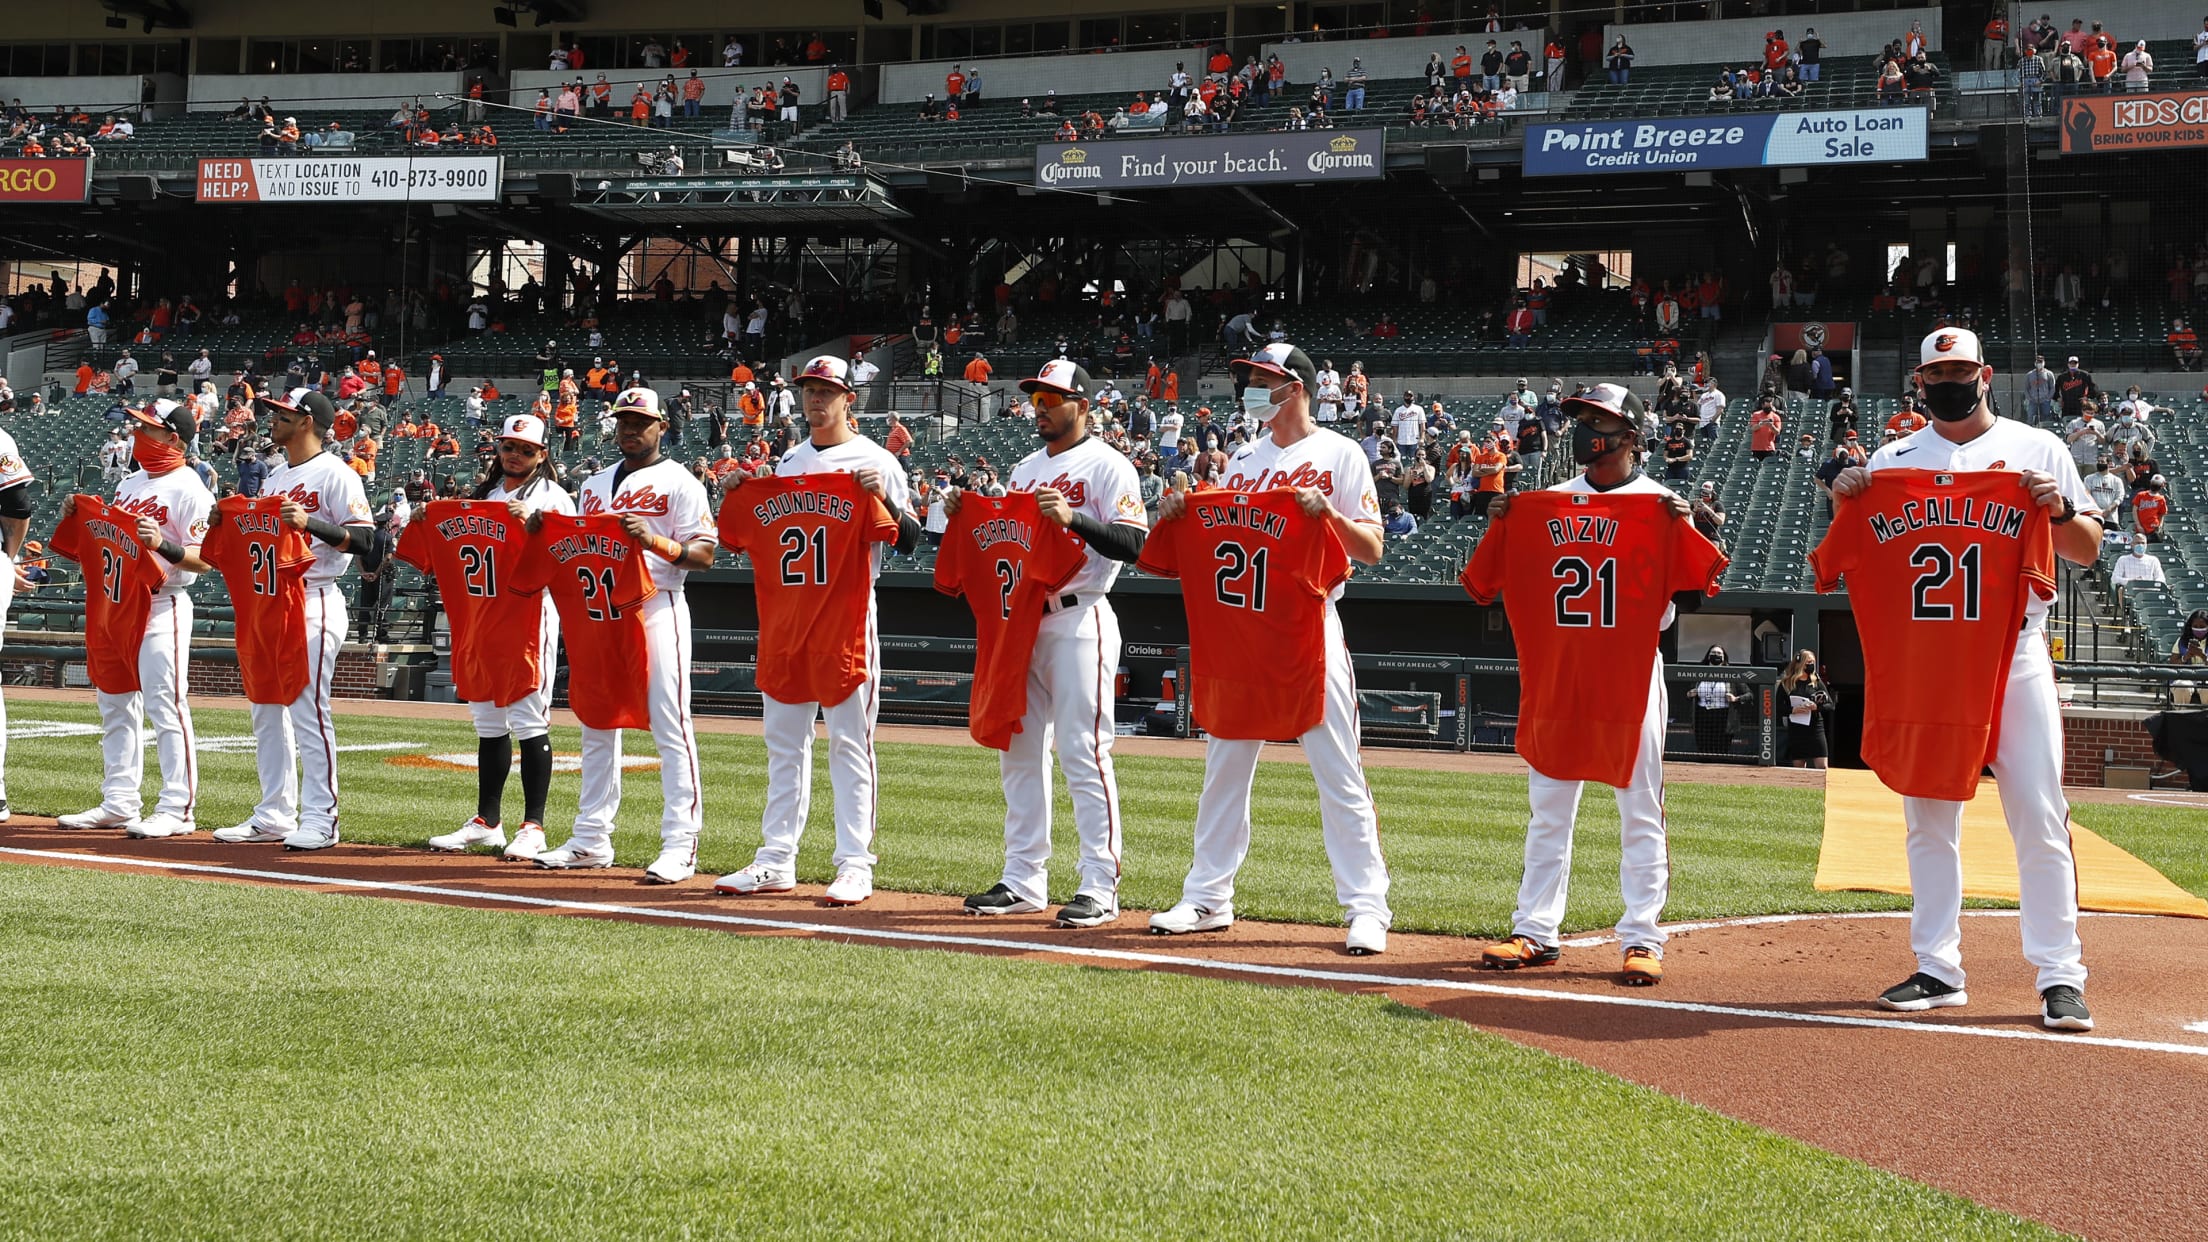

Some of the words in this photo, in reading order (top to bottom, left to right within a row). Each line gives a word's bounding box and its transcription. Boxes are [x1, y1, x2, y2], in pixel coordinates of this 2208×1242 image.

[1633, 125, 1744, 148] Breeze
[1796, 117, 1847, 134] Auto
[1855, 115, 1903, 131] Loan
[2093, 133, 2133, 145] BRING
[2136, 131, 2170, 143] YOUR
[2174, 129, 2204, 141] KIDS
[1586, 152, 1640, 167] Credit
[1645, 150, 1697, 164] Union
[1825, 136, 1874, 158] Sale
[203, 163, 242, 179] NEED
[258, 163, 290, 179] TEXT
[295, 163, 361, 179] LOCATION
[1041, 162, 1102, 184] Corona
[1120, 154, 1166, 178] Find
[1172, 160, 1217, 183] your
[1307, 150, 1374, 174] Corona
[203, 182, 249, 198] HELP?
[269, 181, 295, 196] AND
[300, 181, 339, 196] ISSUE
[345, 181, 360, 196] TO
[371, 169, 487, 188] 410-873-9900
[1591, 437, 1605, 452] 31
[753, 491, 854, 526] SAUNDERS
[1197, 504, 1288, 540] SAWICKI
[1868, 496, 2027, 544] McCALLUM
[234, 513, 280, 536] KELEN
[437, 515, 507, 542] WEBSTER
[973, 518, 1032, 552] CARROLL
[1546, 516, 1619, 546] RIZVI
[85, 519, 118, 545] THANK
[118, 528, 138, 560] YOU
[249, 541, 276, 596] 21
[780, 525, 827, 586] 21
[101, 545, 122, 603] 21
[459, 545, 497, 597] 21
[1214, 540, 1269, 612] 21
[1909, 543, 1982, 621] 21
[577, 566, 622, 621] 21
[1552, 556, 1617, 628] 21
[1406, 661, 1437, 669] AMERICA
[1677, 671, 1697, 679] BANK
[1709, 672, 1741, 680] AMERICA
[1176, 667, 1185, 732] Orioles.com
[1456, 677, 1467, 746] Orioles.com
[1761, 688, 1772, 760] Orioles.com
